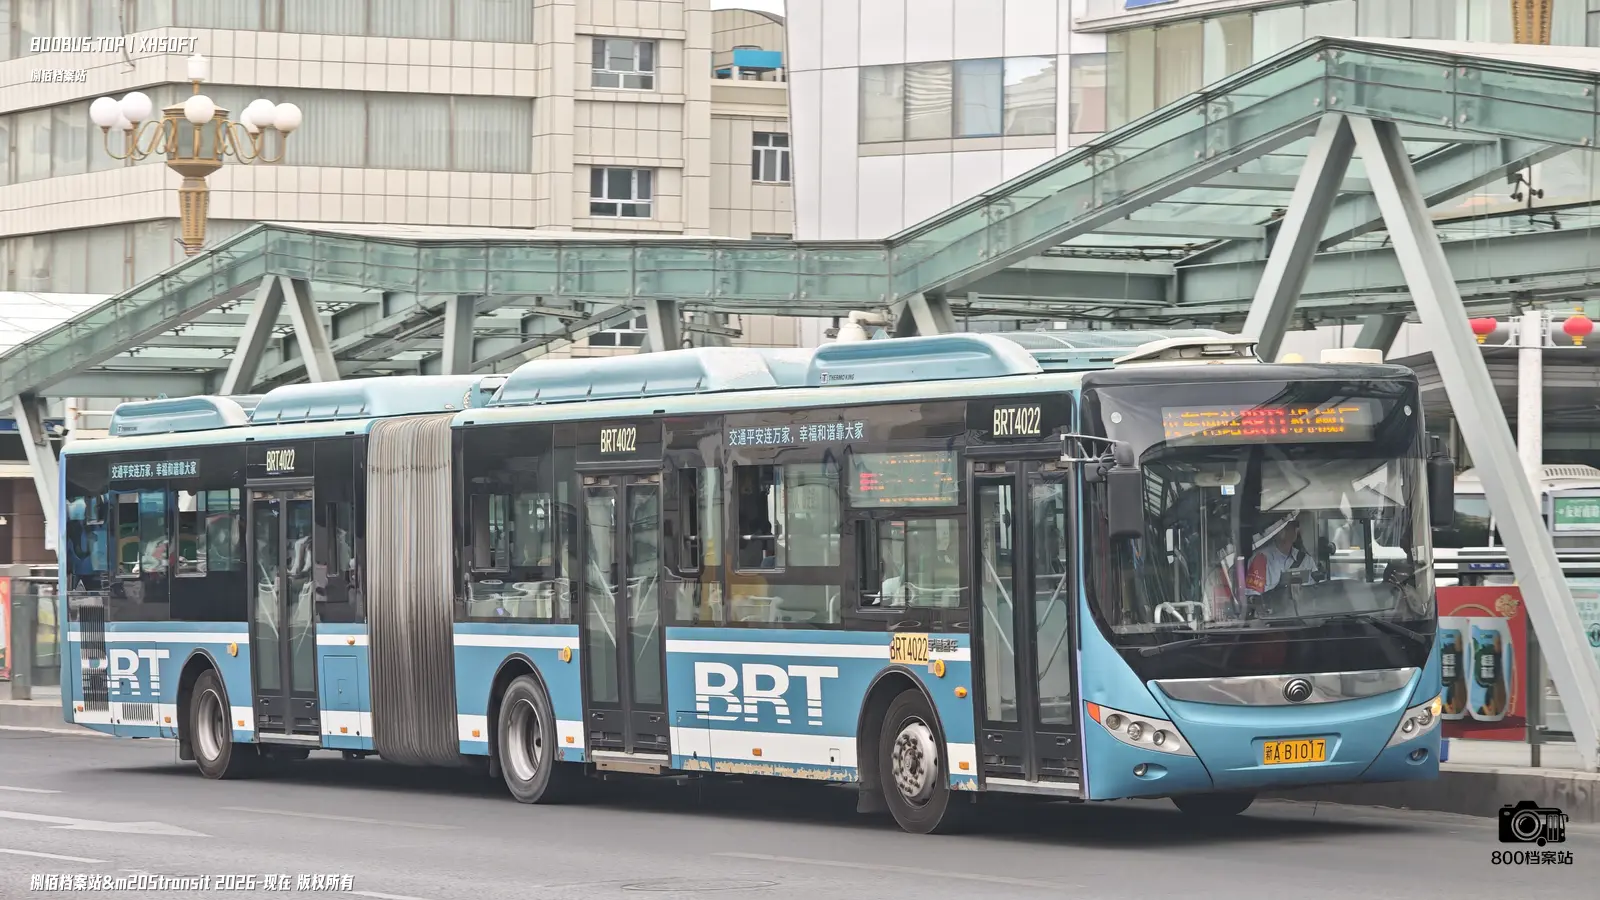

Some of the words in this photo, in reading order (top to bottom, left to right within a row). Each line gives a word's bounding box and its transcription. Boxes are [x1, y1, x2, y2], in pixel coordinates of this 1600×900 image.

[993, 406, 1041, 436] BRT4022
[600, 427, 636, 453] BRT4022
[266, 449, 295, 472] BRT4022
[890, 636, 928, 662] BRT4022
[694, 661, 839, 726] BRT
